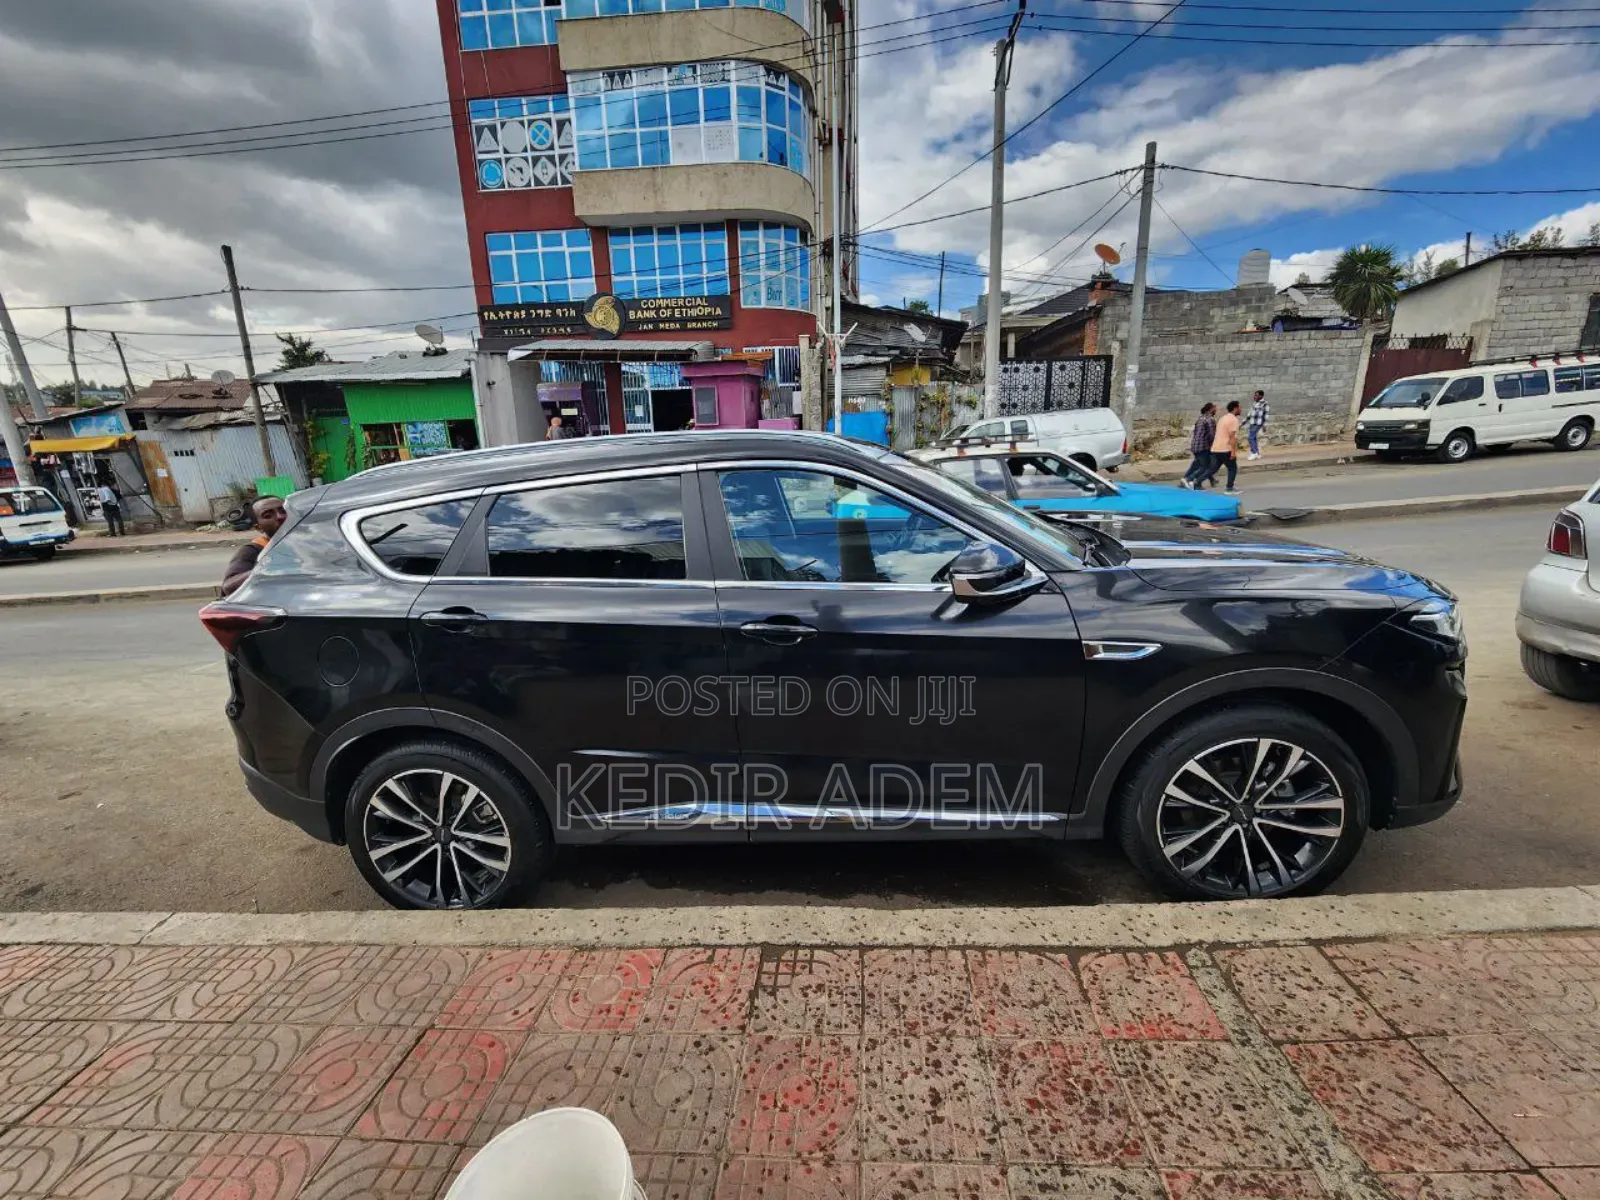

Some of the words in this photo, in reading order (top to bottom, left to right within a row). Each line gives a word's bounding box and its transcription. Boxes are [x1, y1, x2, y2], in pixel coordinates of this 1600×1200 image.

[640, 297, 709, 309] COMMERCIAL
[628, 309, 658, 320] BANK
[659, 308, 673, 318] OF
[674, 305, 723, 317] ETHIOPIA
[687, 321, 719, 329] BRANCH
